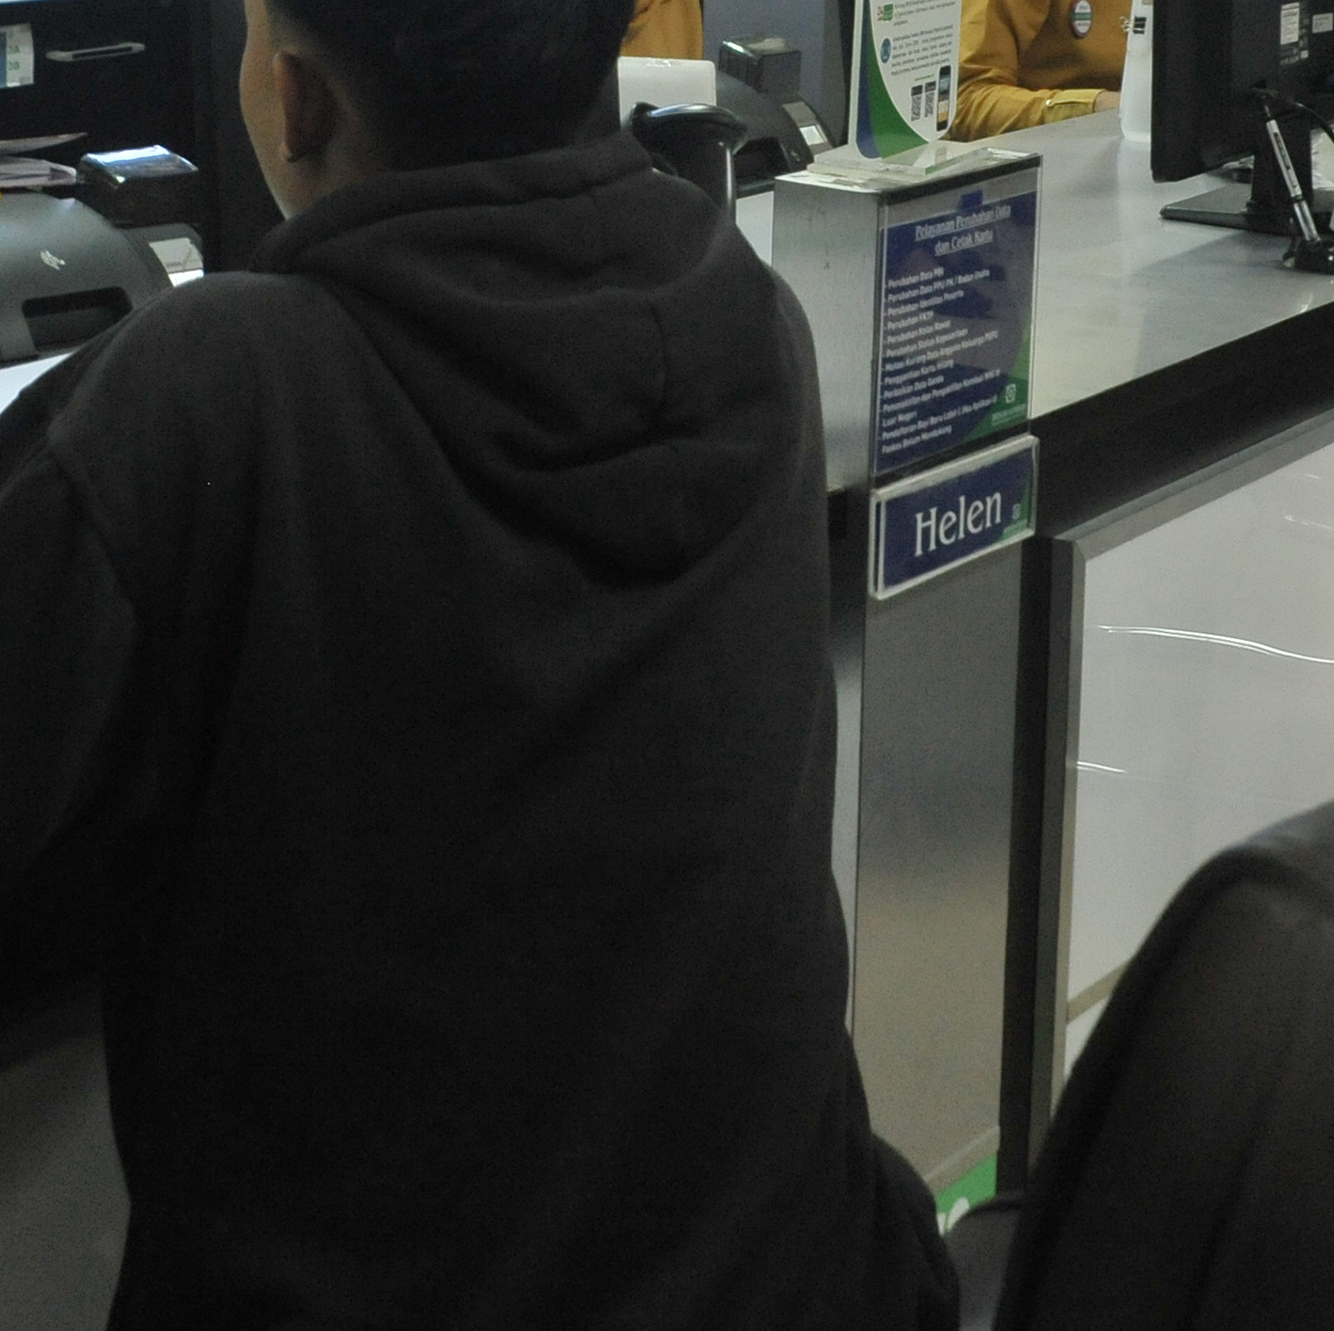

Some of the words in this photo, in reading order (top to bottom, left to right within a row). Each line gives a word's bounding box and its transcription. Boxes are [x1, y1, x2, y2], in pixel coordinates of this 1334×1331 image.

[915, 220, 955, 240] Pelayanan
[956, 210, 994, 230] Perubahan
[995, 205, 1011, 220] Data
[935, 240, 950, 255] dan
[951, 233, 973, 250] Cetak
[974, 229, 994, 245] Kartu
[914, 492, 1002, 557] Helen
